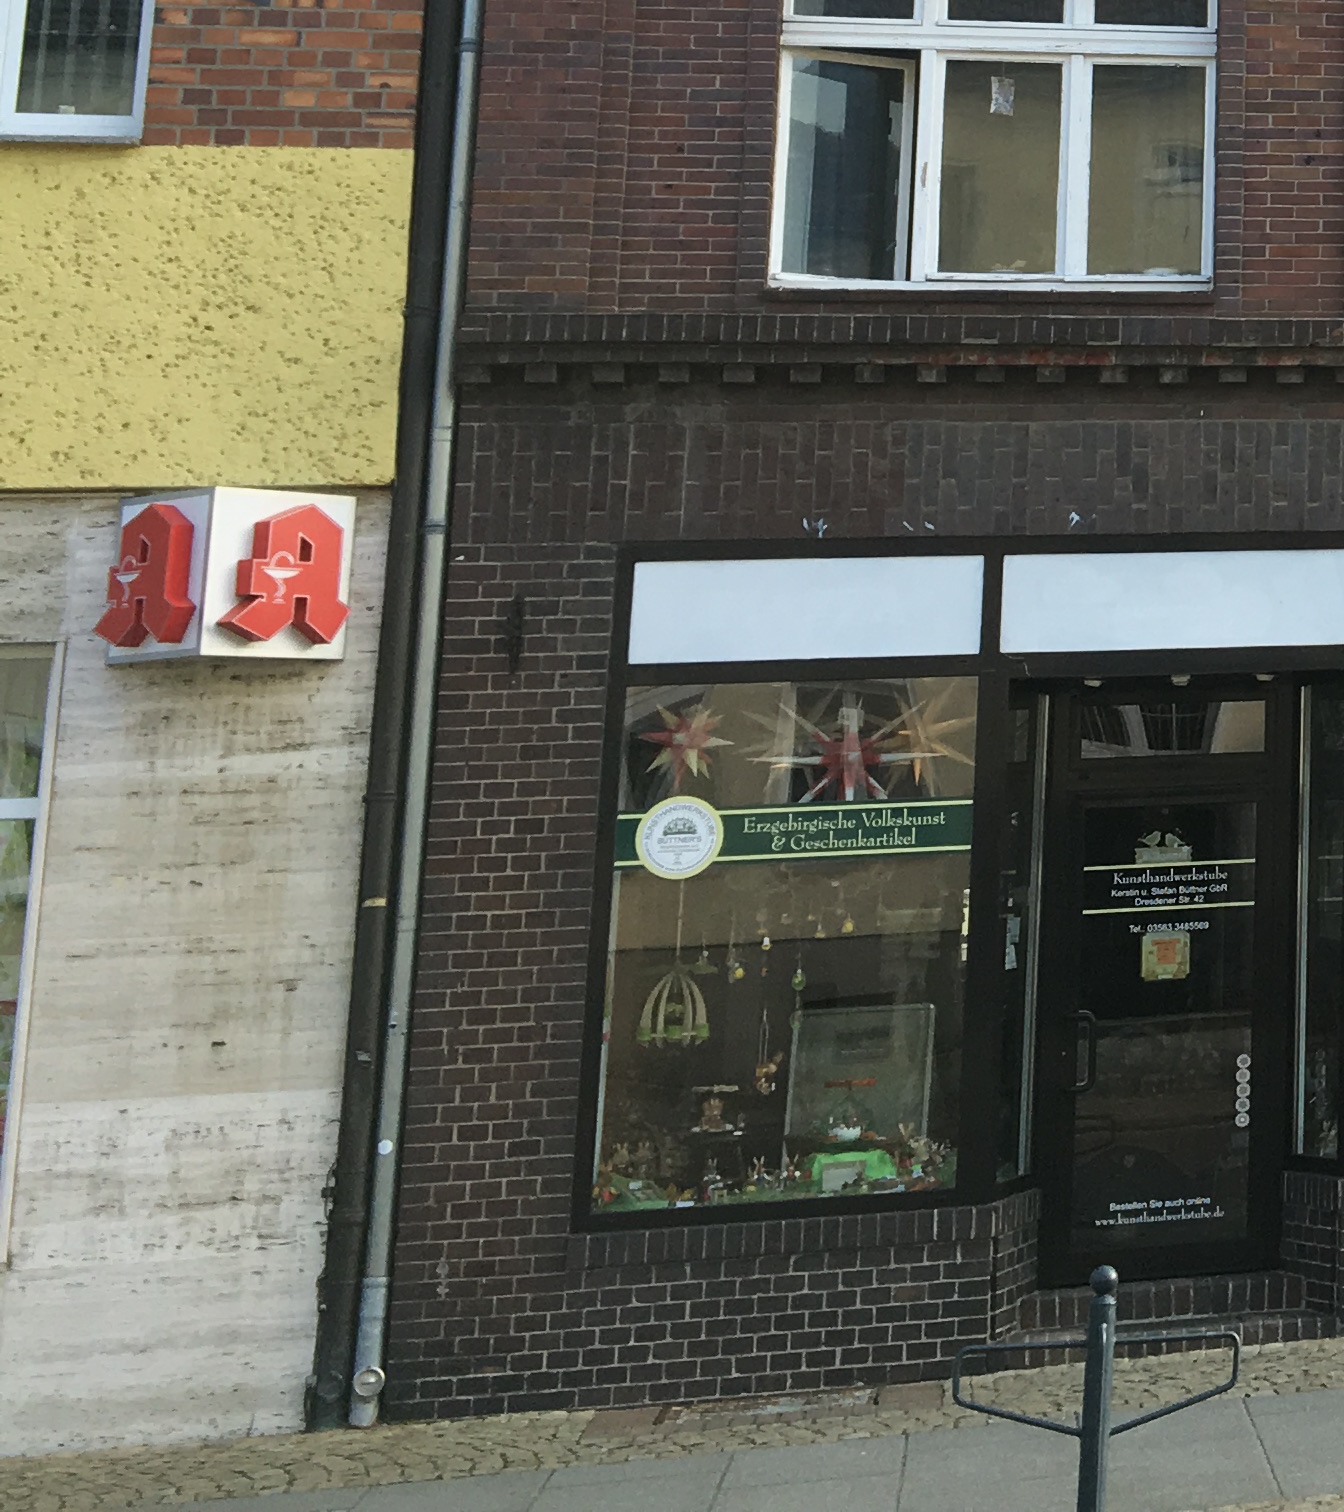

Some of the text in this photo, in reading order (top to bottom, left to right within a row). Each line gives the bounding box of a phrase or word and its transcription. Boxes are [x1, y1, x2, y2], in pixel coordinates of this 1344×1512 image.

[742, 808, 946, 835] Erzgebirgische Volkskunst
[771, 827, 916, 852] & Geschenkartikel
[1113, 865, 1229, 885] Kunsthandwerkstube
[1095, 1206, 1225, 1226] www.kunsthandwerkstube.de
